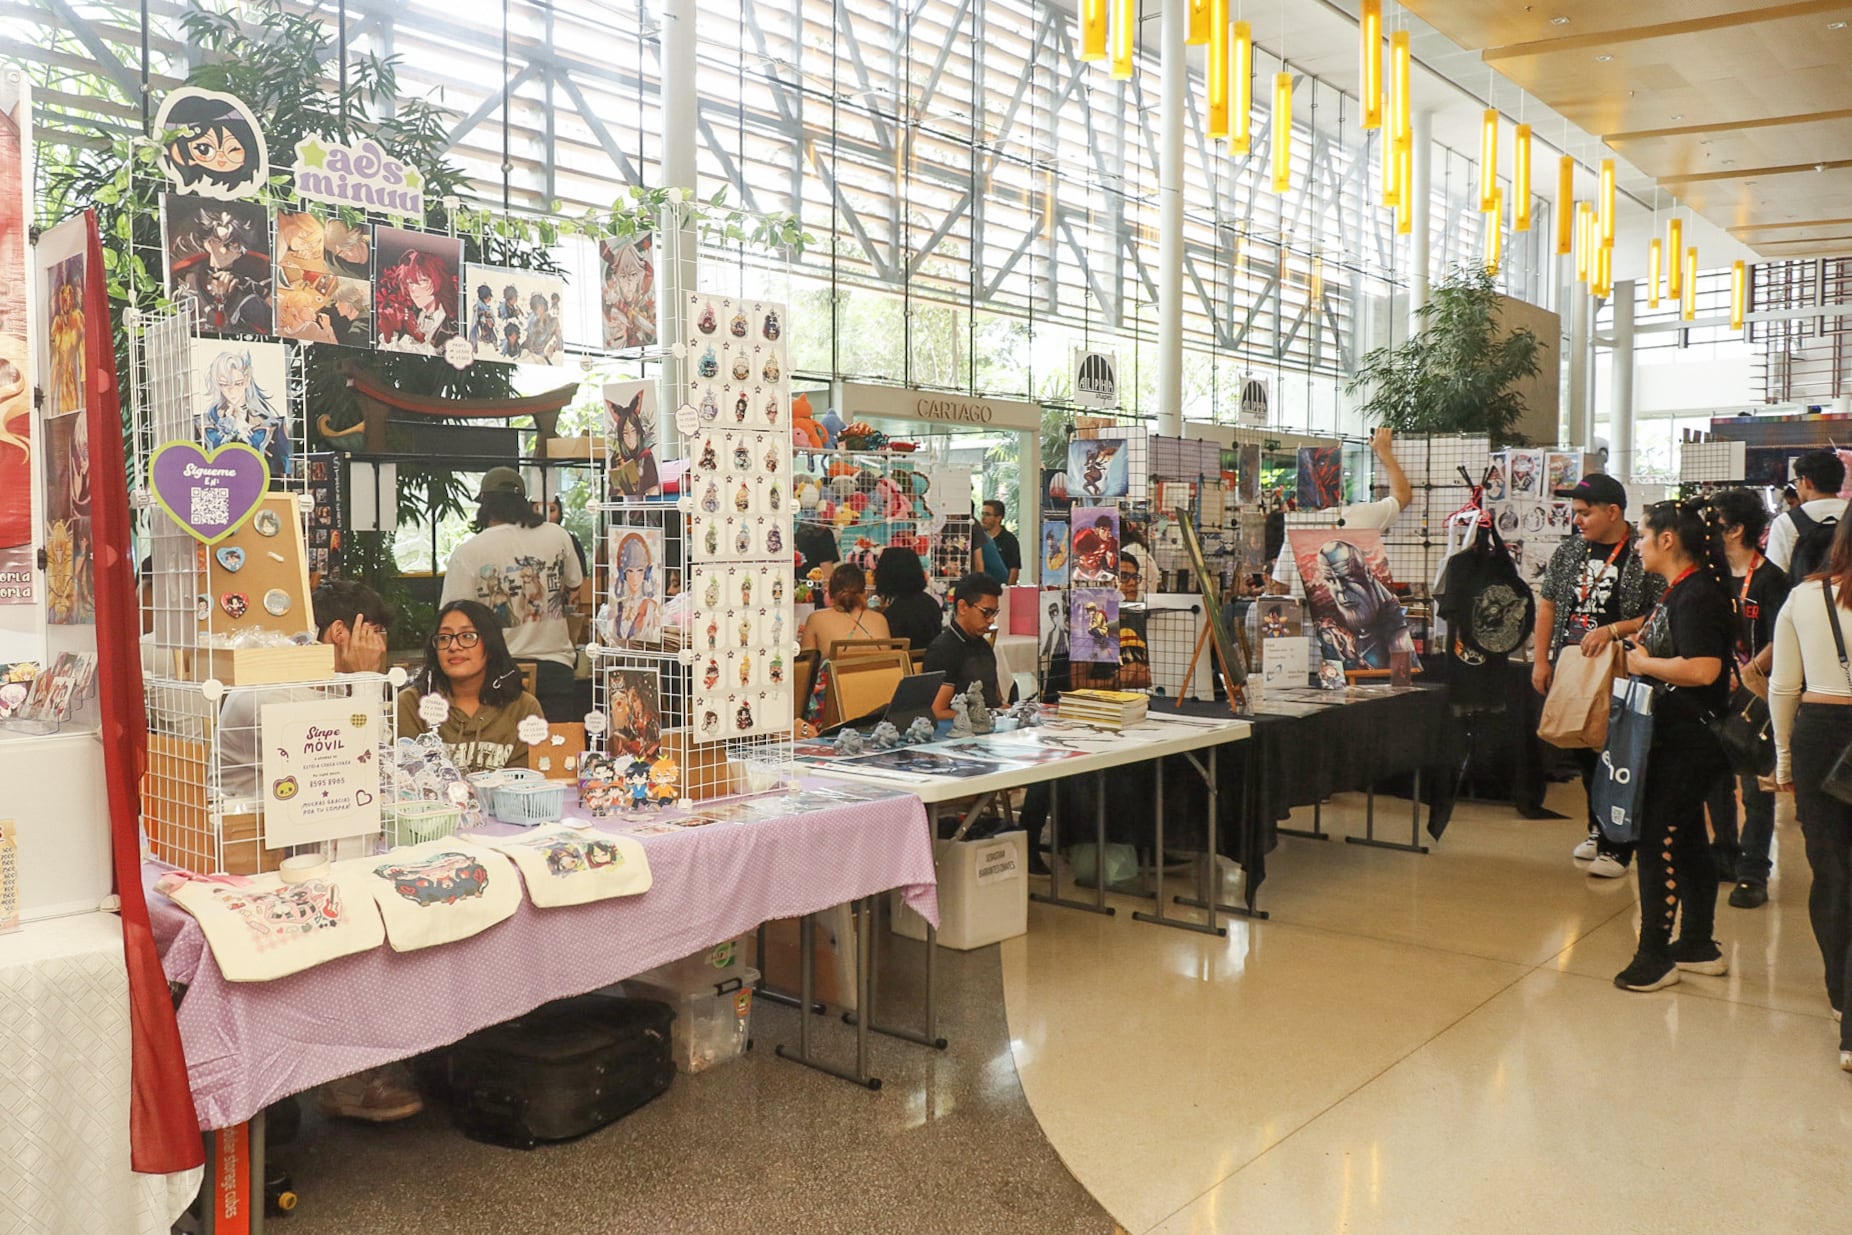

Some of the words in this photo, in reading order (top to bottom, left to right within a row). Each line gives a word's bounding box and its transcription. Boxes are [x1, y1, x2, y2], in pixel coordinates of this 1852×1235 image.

[327, 143, 403, 185] aes
[299, 172, 420, 213] minuu
[917, 399, 992, 423] CARTAGO
[304, 738, 345, 754] MÓVIL
[306, 726, 341, 740] Sinpe
[224, 1191, 241, 1219] cubes
